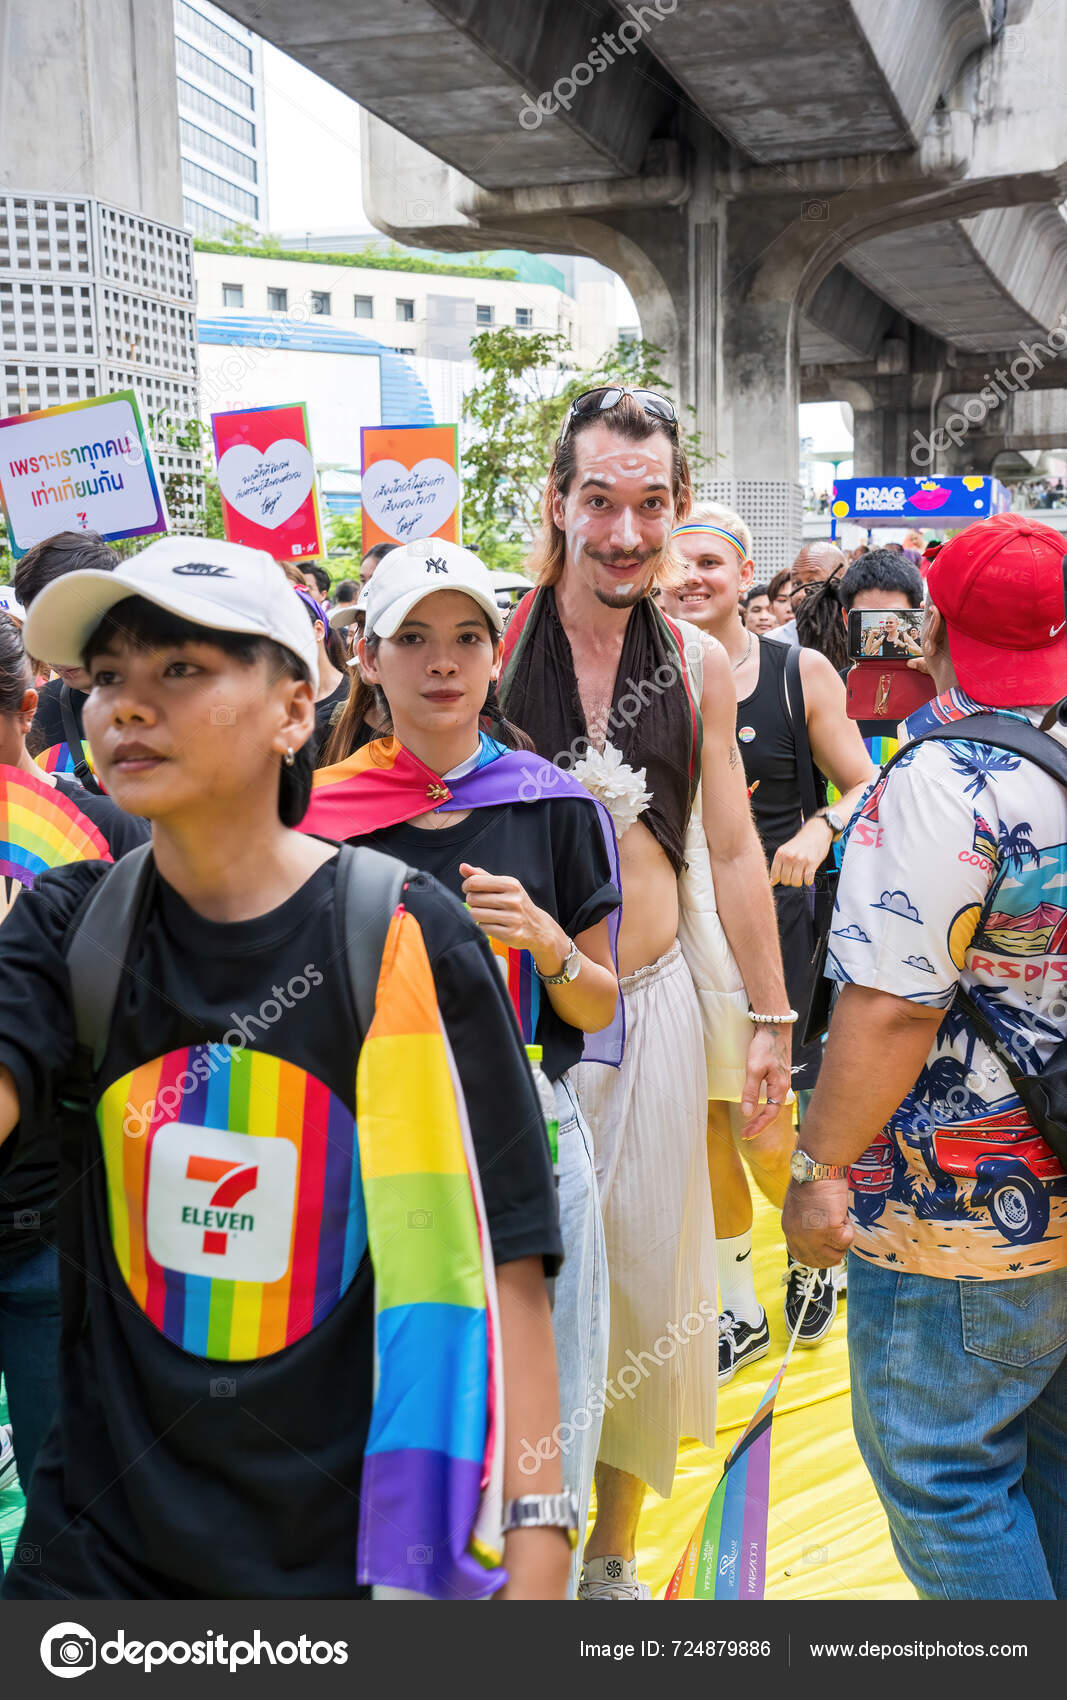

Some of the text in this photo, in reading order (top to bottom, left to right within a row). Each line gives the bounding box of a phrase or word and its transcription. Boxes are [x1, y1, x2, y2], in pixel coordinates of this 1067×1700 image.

[9, 436, 132, 478] เพราะเราทุกคน
[31, 470, 124, 508] เท่าเทียมกัน
[856, 487, 906, 503] DRAG
[425, 557, 449, 574] NY
[185, 1155, 259, 1256] 7
